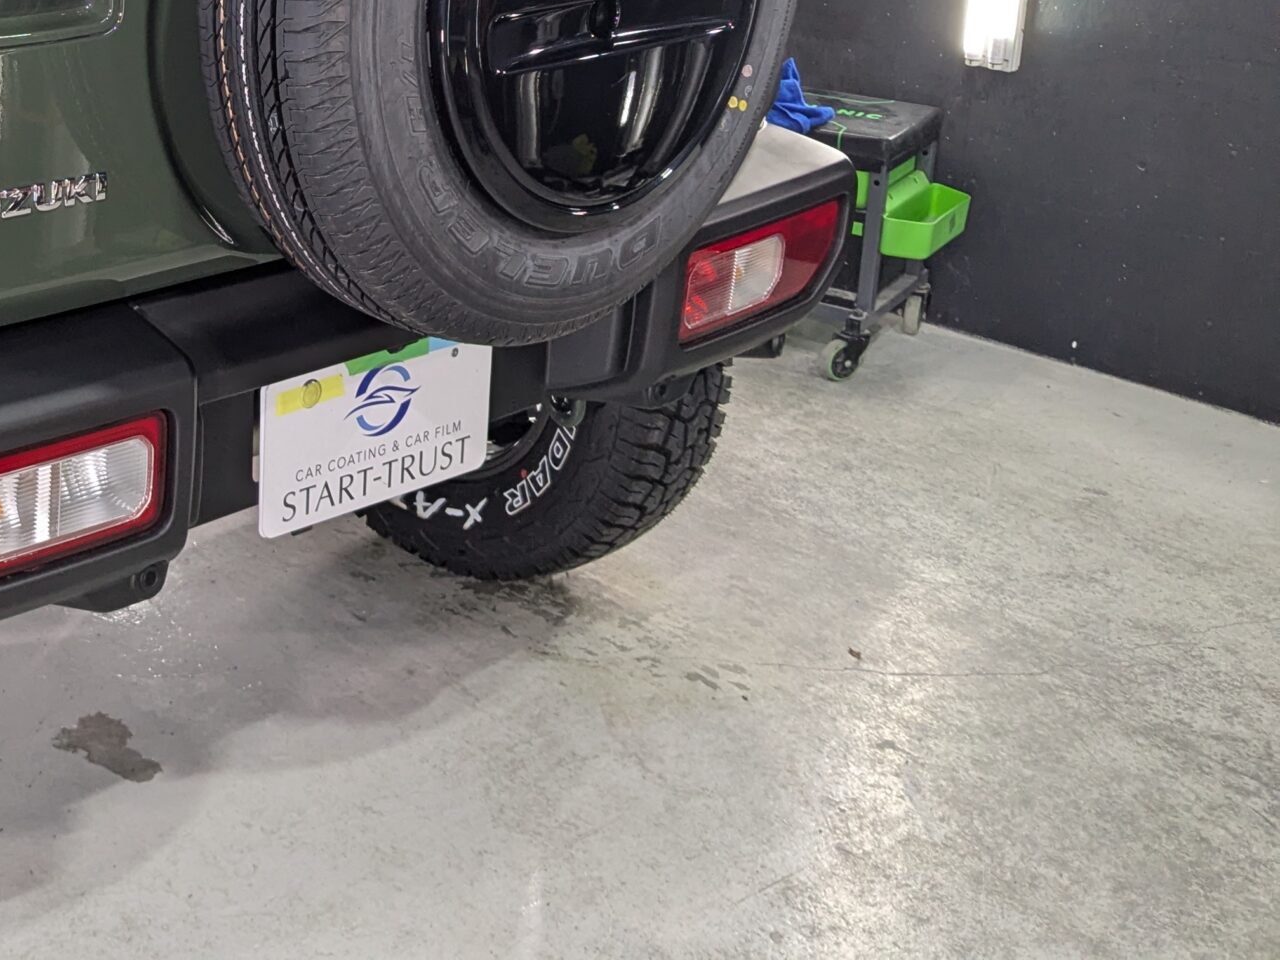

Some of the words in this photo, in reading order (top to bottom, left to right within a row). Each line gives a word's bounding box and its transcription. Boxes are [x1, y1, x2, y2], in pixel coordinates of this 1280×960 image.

[418, 154, 662, 287] DUELER
[282, 435, 472, 522] START-TRUST
[295, 464, 322, 482] CAR
[327, 444, 387, 472] COATING
[391, 440, 400, 452] &
[405, 430, 430, 448] CAR
[434, 420, 462, 439] FILM
[503, 425, 577, 516] DAR
[388, 490, 488, 529] X-A
